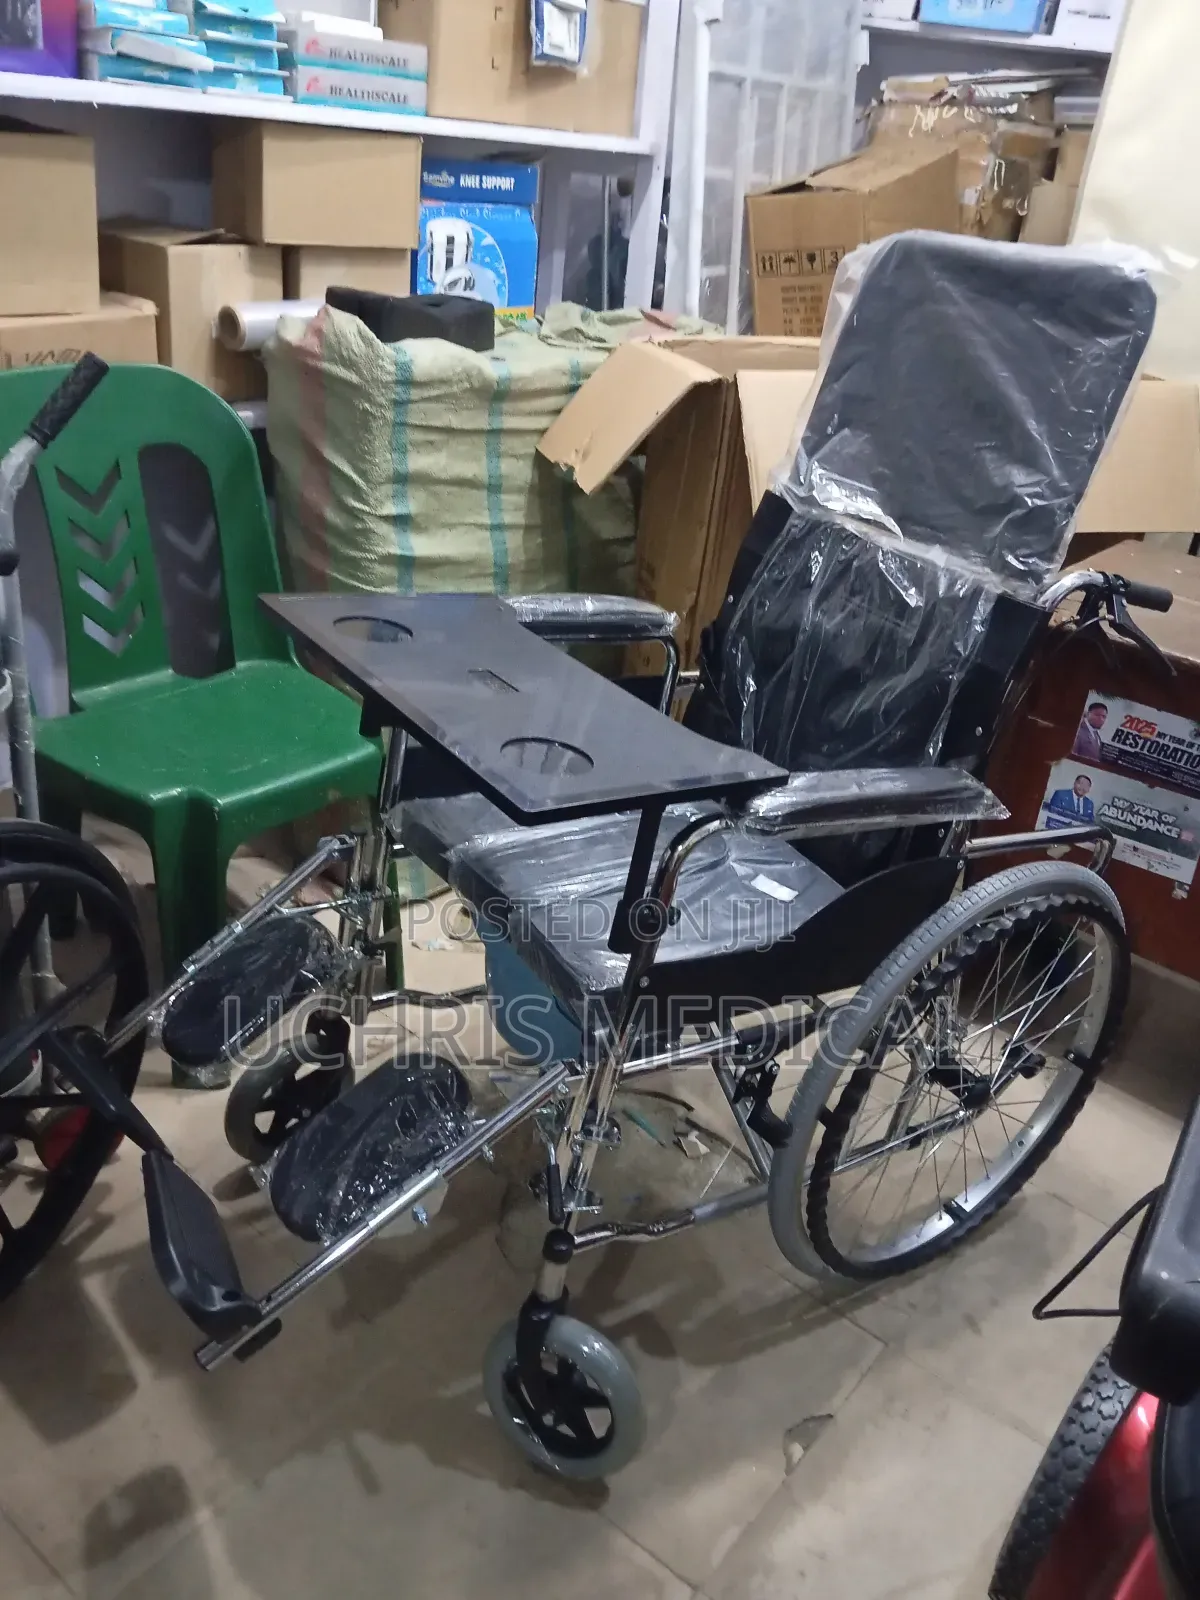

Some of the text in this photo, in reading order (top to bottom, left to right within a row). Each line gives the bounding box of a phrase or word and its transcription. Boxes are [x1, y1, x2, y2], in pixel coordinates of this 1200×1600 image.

[329, 47, 409, 68] HEALTHSCALE
[329, 84, 409, 104] HEALTHSCALE
[460, 174, 480, 189] KNEE
[481, 175, 515, 192] SUPPORT
[1098, 804, 1181, 839] ABUNDANCE
[1113, 797, 1177, 825] MY YEAR OF
